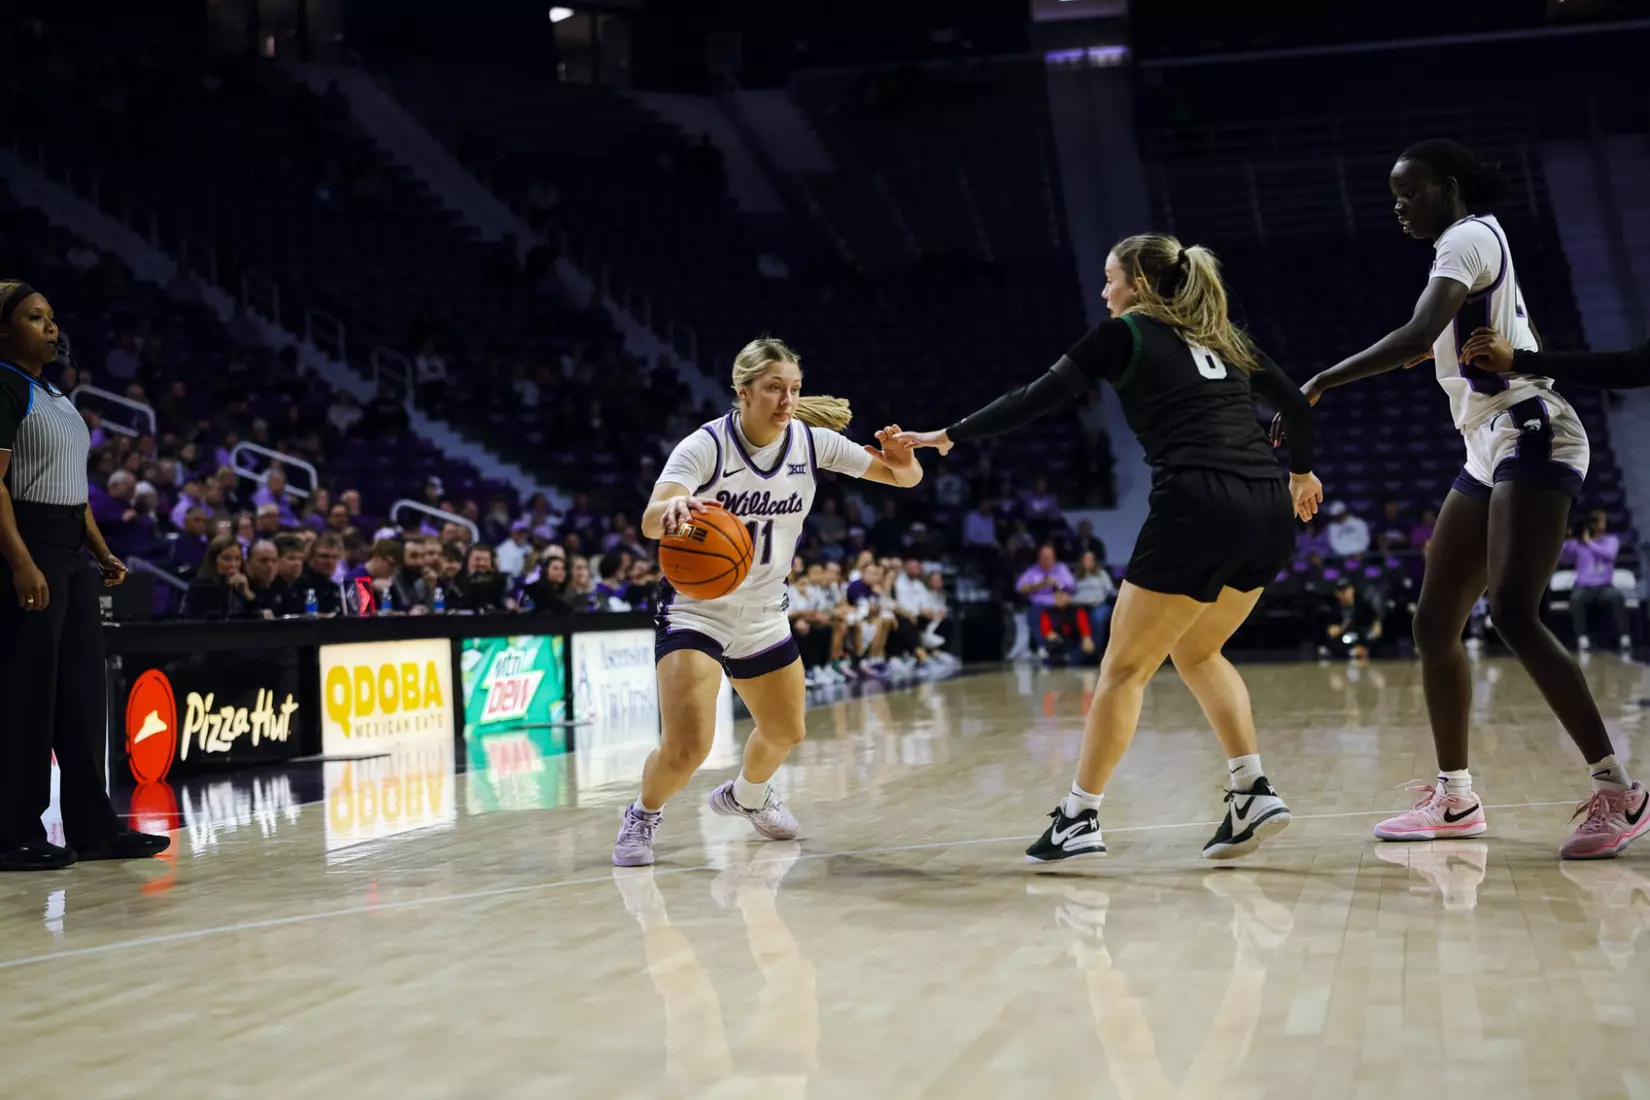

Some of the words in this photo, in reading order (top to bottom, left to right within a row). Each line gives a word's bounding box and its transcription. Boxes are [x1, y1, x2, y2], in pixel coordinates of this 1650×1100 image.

[716, 490, 803, 516] Wildcats
[180, 691, 251, 762] Pizza
[249, 687, 299, 747] Hut
[326, 660, 444, 740] QDOBA
